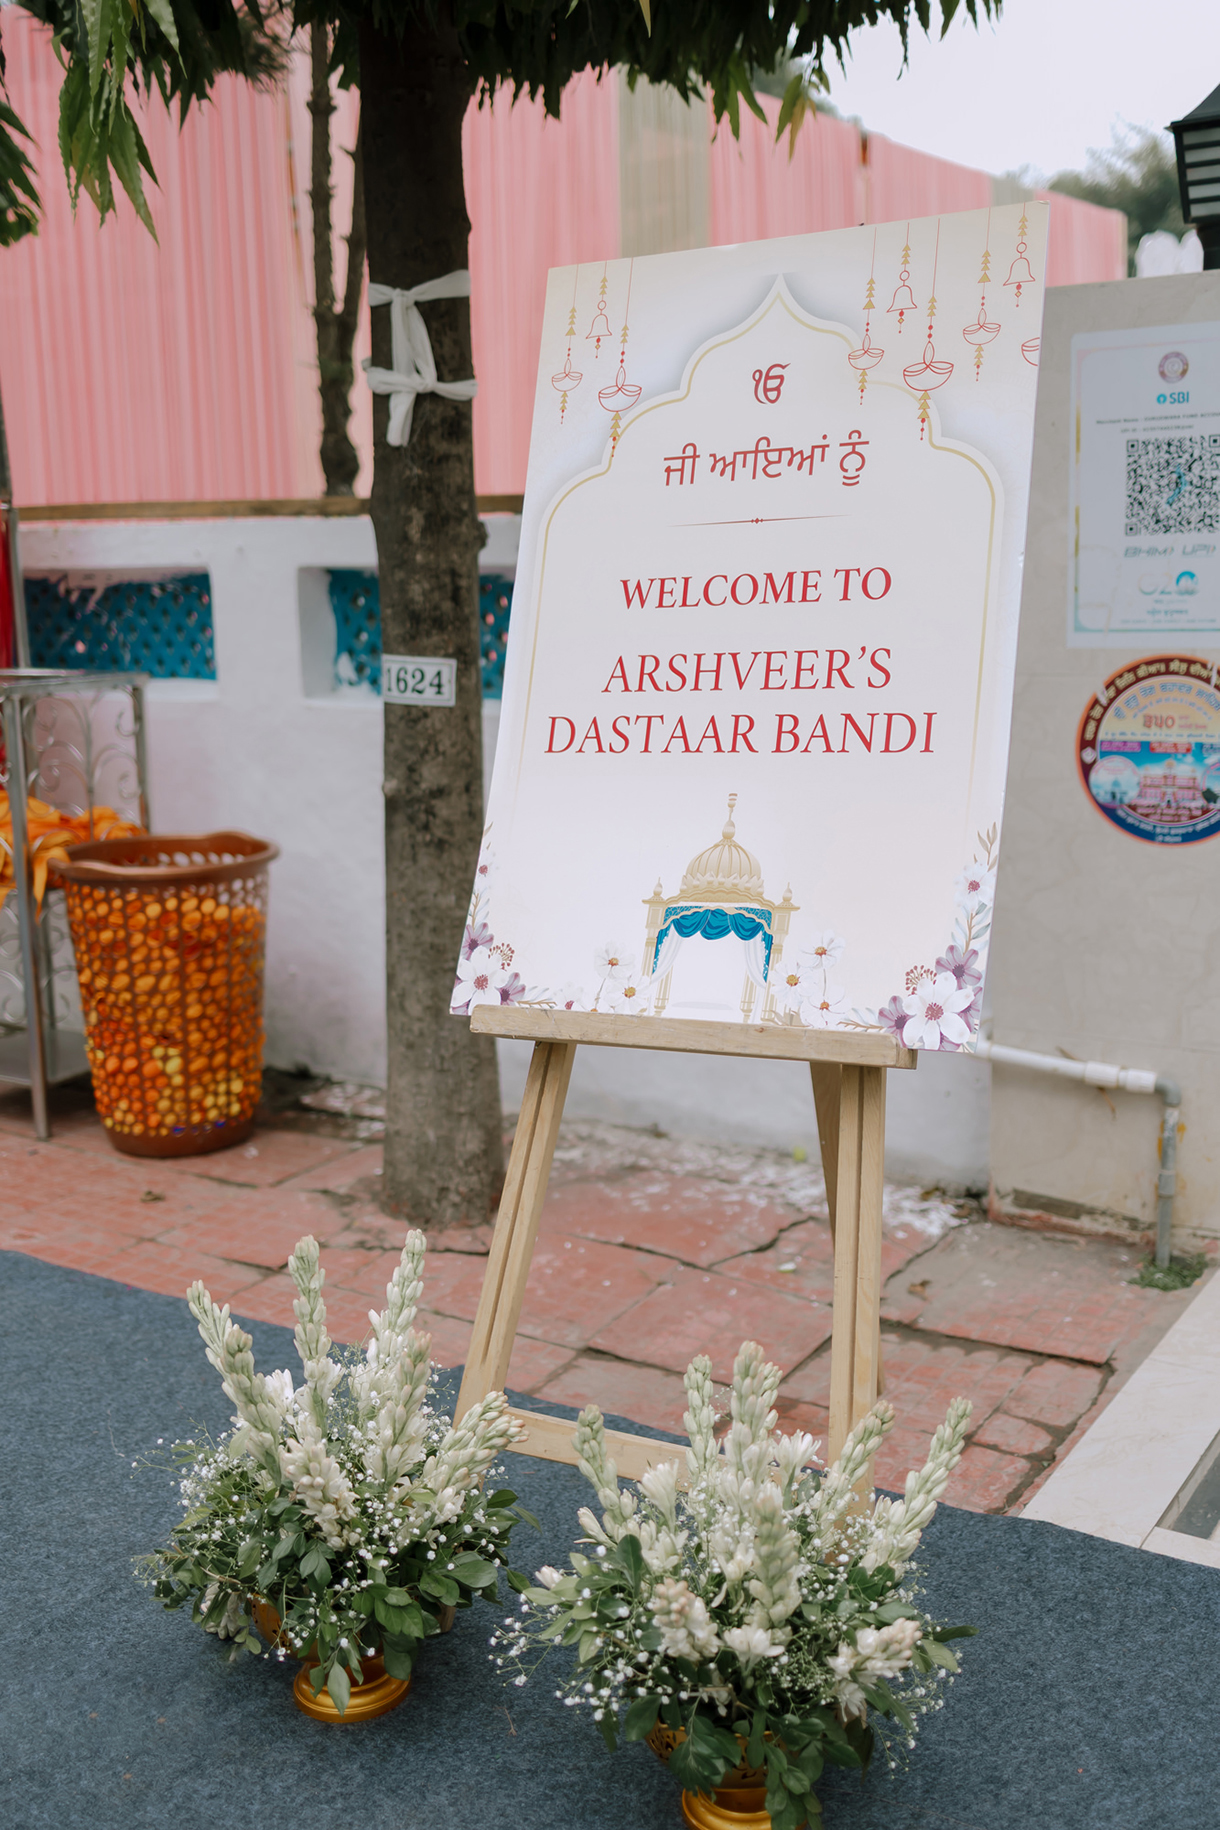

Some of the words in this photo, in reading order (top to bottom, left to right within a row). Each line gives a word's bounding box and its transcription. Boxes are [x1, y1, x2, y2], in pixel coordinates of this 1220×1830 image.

[1169, 391, 1190, 405] SBI
[663, 442, 701, 486] ਜੀ
[708, 434, 830, 482] ਆਇਆਂ
[838, 429, 870, 487] ਨੂੰ
[619, 569, 822, 610] WELCOME
[833, 566, 892, 602] TO
[386, 666, 444, 695] 1624
[601, 645, 892, 694] ARSHVEER’S
[543, 713, 760, 754] DASTAAR
[770, 711, 938, 754] BANDI
